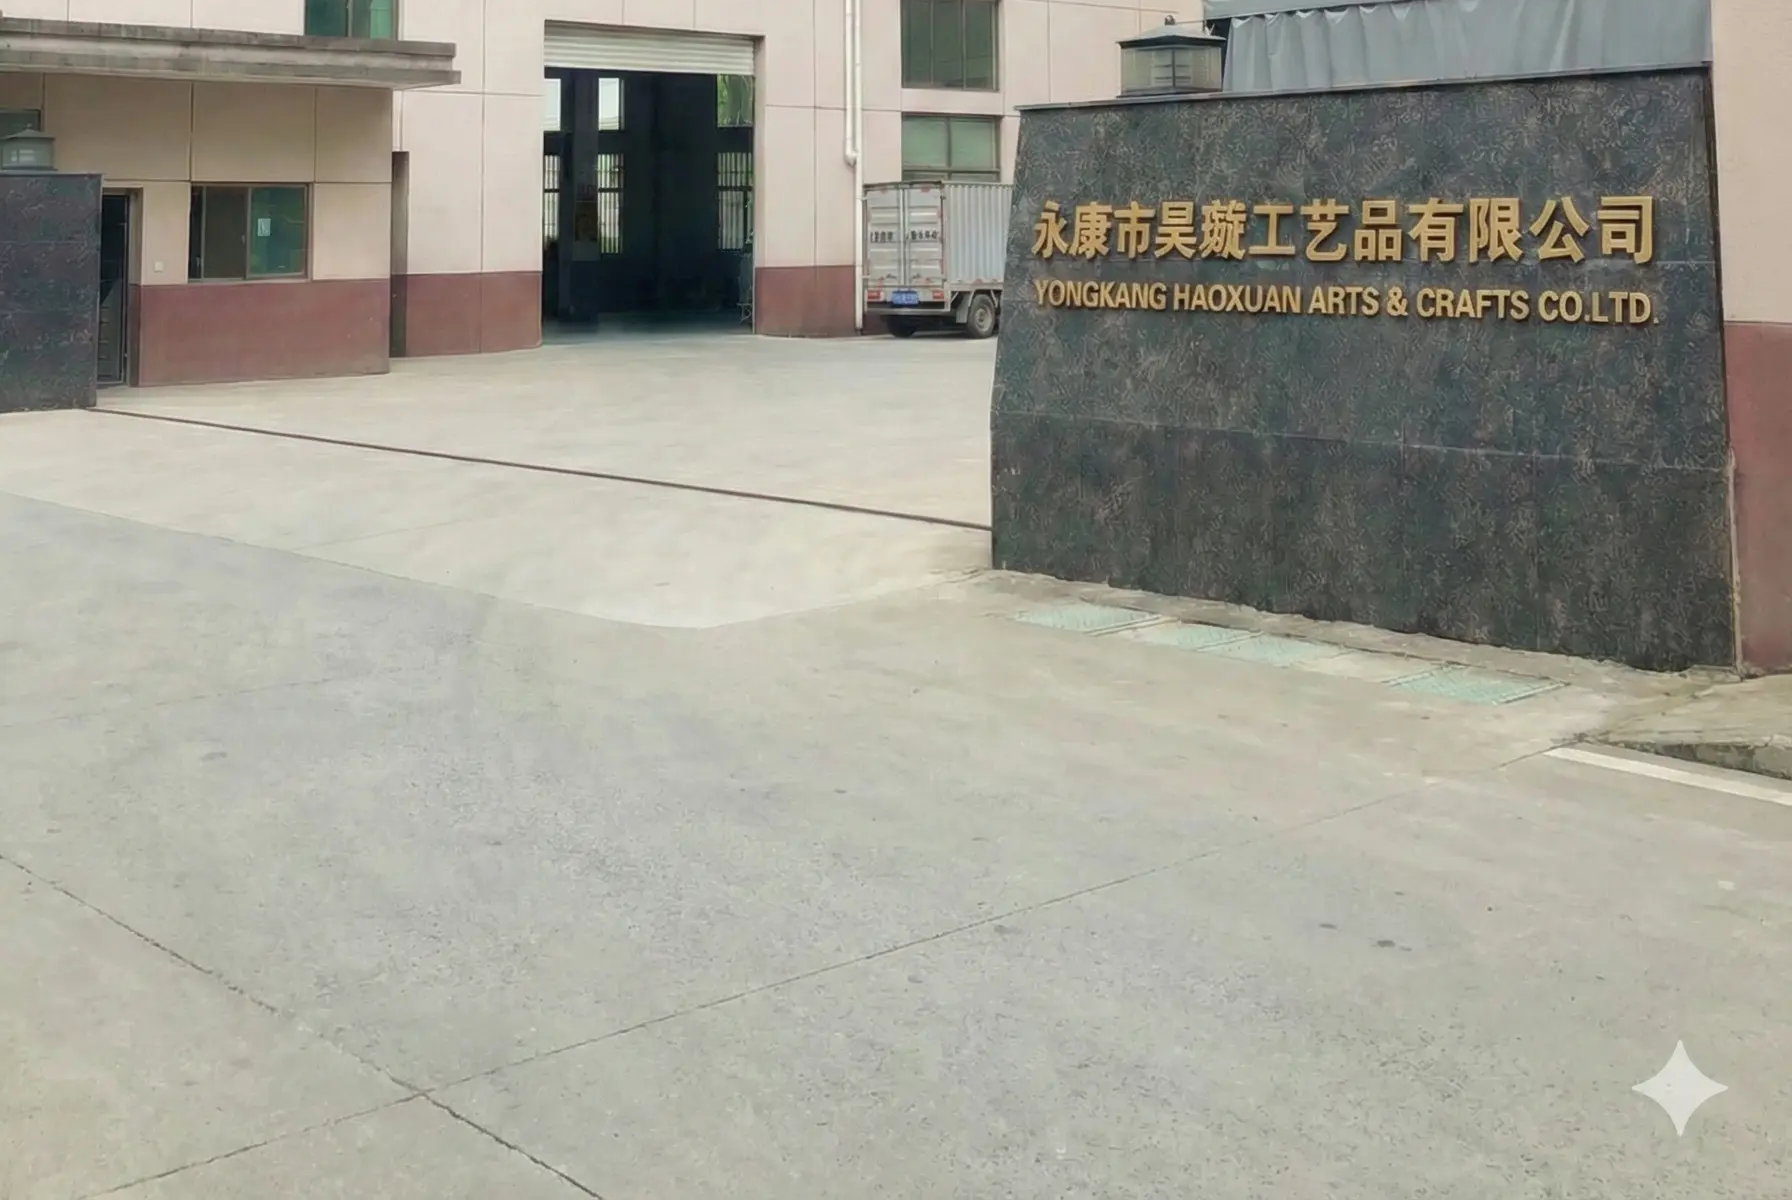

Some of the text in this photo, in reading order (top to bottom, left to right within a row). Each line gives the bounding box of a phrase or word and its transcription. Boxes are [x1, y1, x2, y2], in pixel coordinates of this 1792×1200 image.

[1034, 279, 1166, 310] YONGKANG
[1173, 283, 1301, 314] HAOXUAN
[1308, 286, 1380, 316] ARTS
[1387, 286, 1409, 317] &
[1416, 288, 1531, 320] CRAFTS
